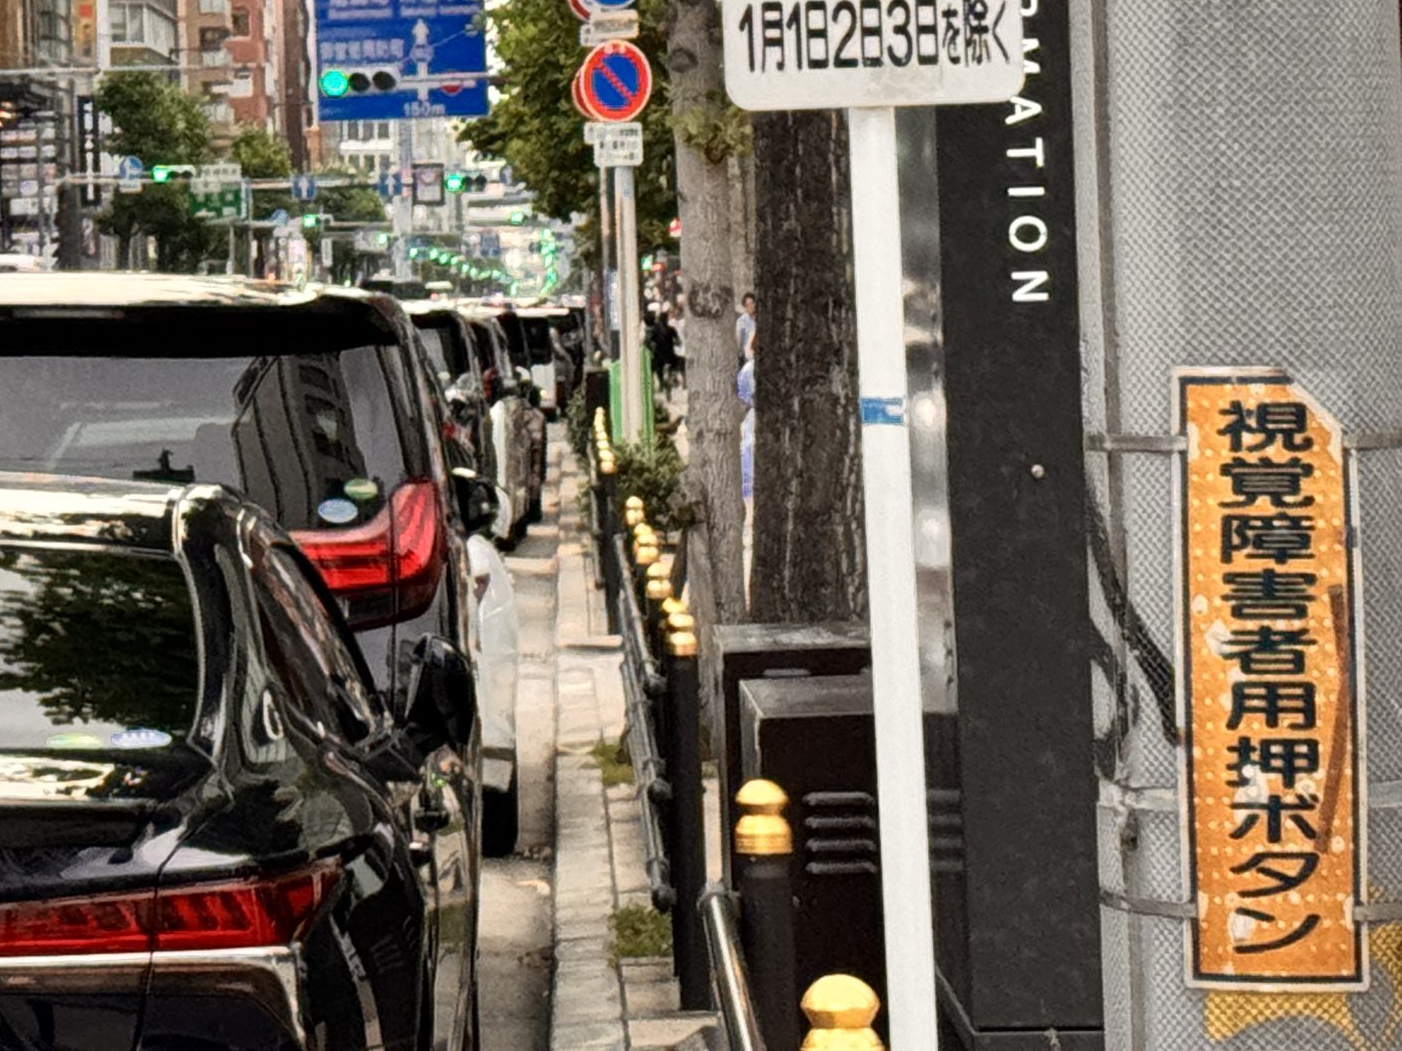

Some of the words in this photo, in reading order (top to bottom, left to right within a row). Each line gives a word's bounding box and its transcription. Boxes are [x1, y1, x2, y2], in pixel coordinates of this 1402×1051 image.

[1216, 398, 1321, 955] 視覚障害者用押ボタン
